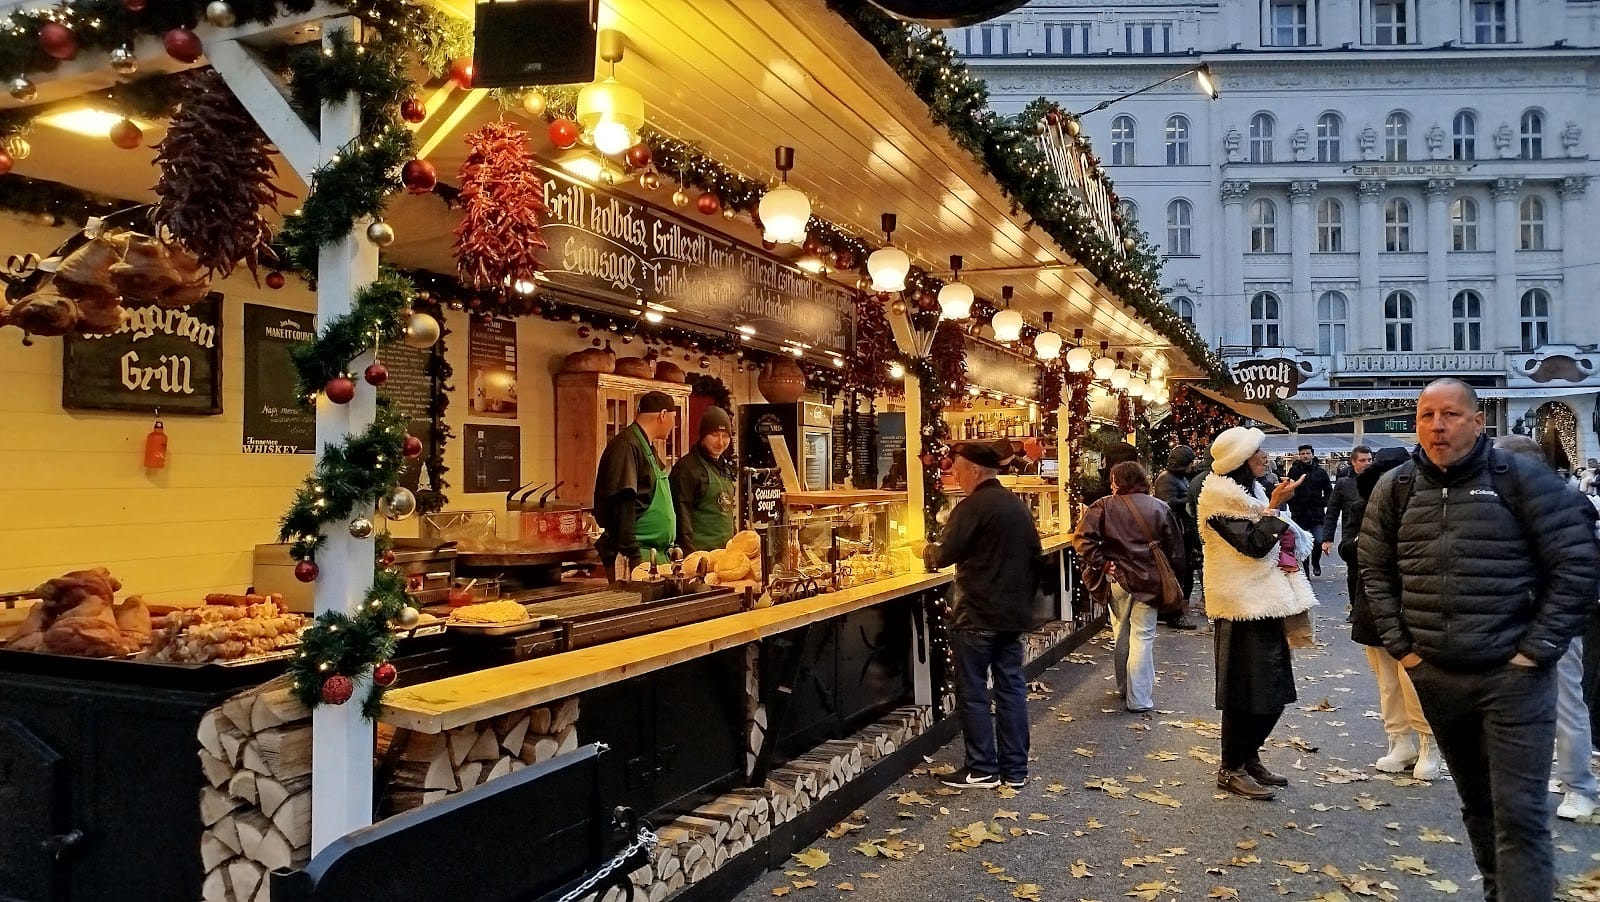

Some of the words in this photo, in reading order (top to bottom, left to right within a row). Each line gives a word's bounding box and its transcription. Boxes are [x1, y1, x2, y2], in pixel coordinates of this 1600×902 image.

[543, 179, 585, 228] Grill
[590, 193, 648, 255] kolbász
[562, 236, 637, 290] Sausage
[82, 303, 216, 349] ngarian
[265, 326, 284, 339] MAKE
[284, 329, 292, 339] IT
[292, 330, 314, 341] COUNT
[121, 351, 194, 394] Grill
[1228, 362, 1291, 385] Forralt
[1243, 381, 1274, 400] Bor
[1384, 418, 1408, 431] HÜTTE
[243, 445, 298, 454] WHISKEY
[246, 436, 279, 445] Tennessee
[758, 500, 776, 512] SOUP
